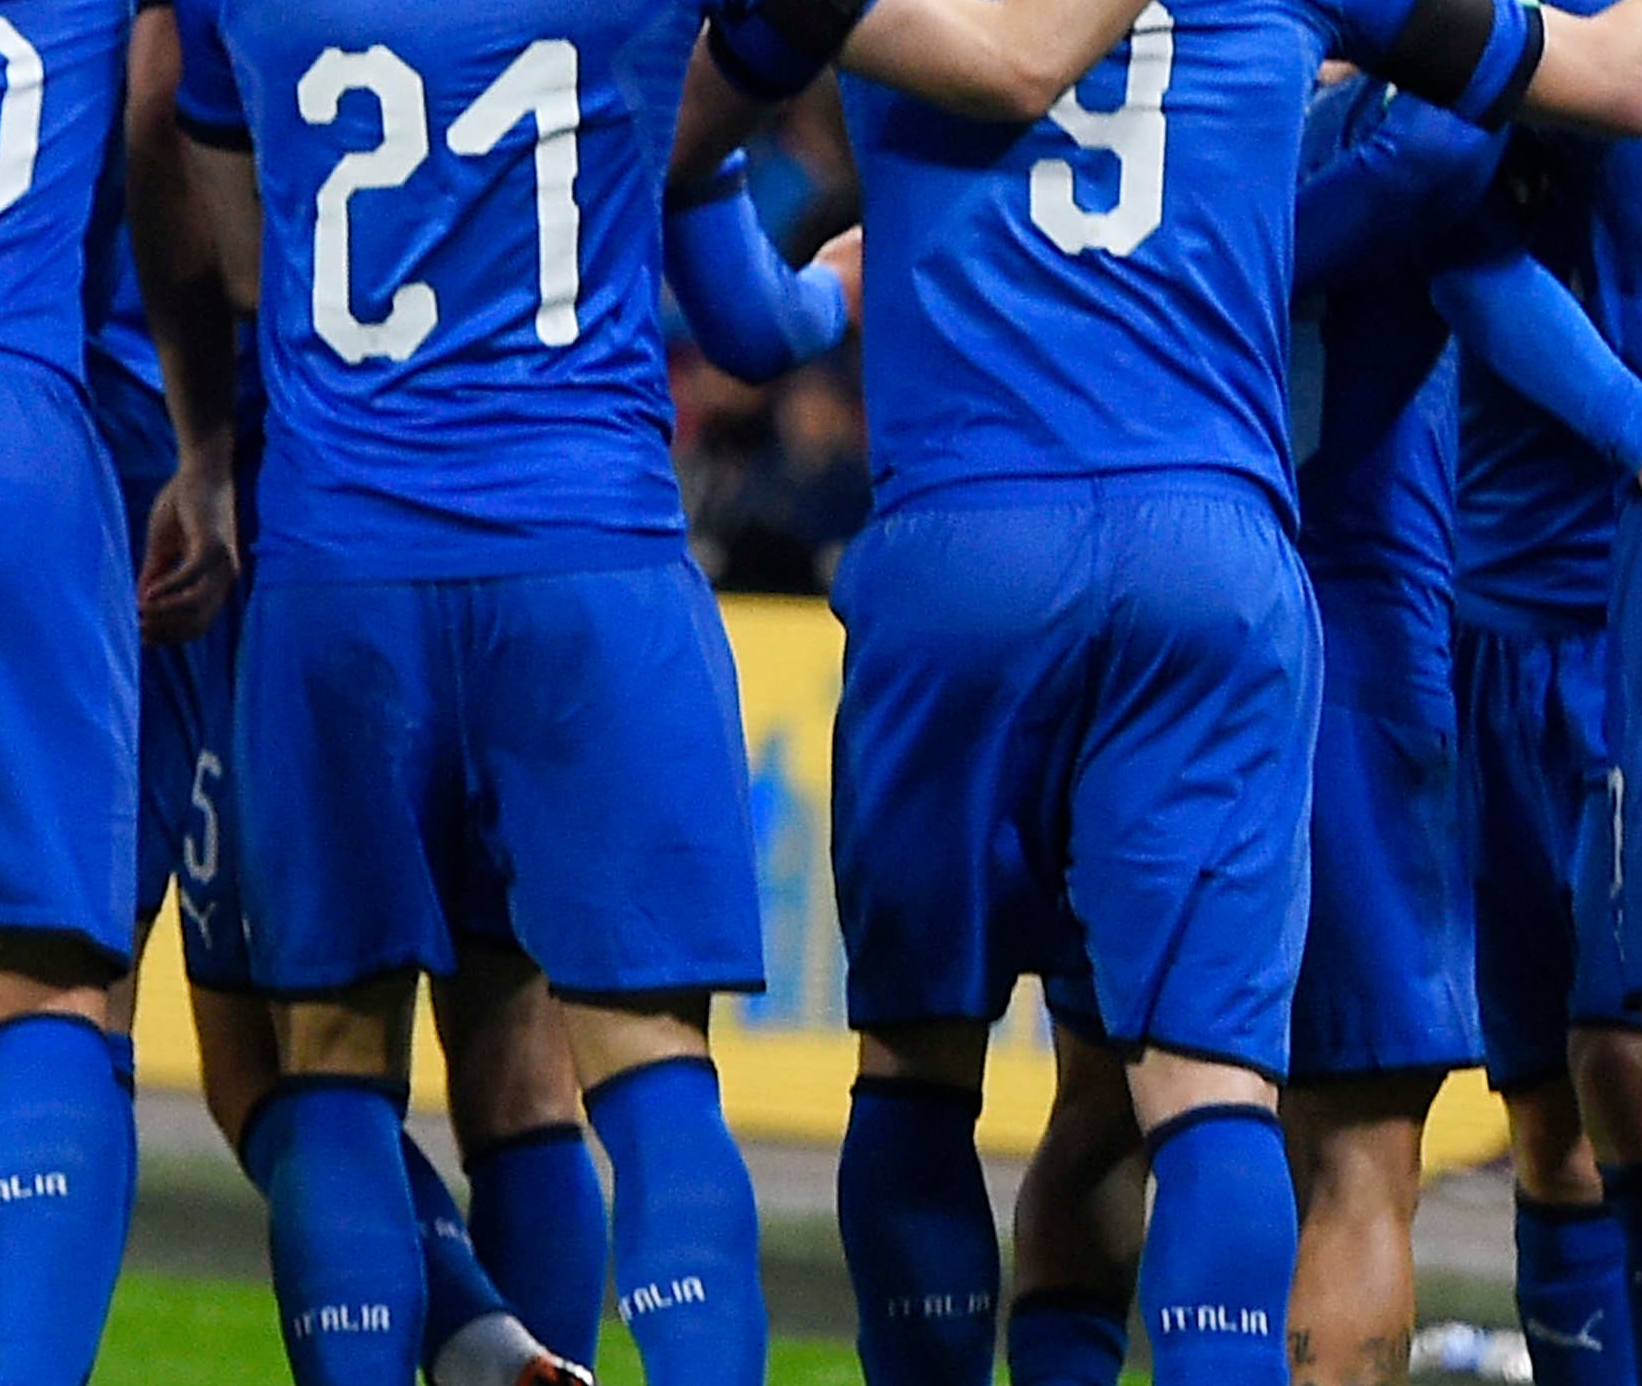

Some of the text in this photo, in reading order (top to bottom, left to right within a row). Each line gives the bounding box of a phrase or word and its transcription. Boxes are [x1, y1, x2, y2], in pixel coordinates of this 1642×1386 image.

[1030, 0, 1174, 257] 9
[297, 38, 578, 364] 21
[293, 1303, 390, 1340] ITALIA
[618, 1276, 706, 1327] ITALIA
[1161, 1304, 1268, 1336] ITALIA
